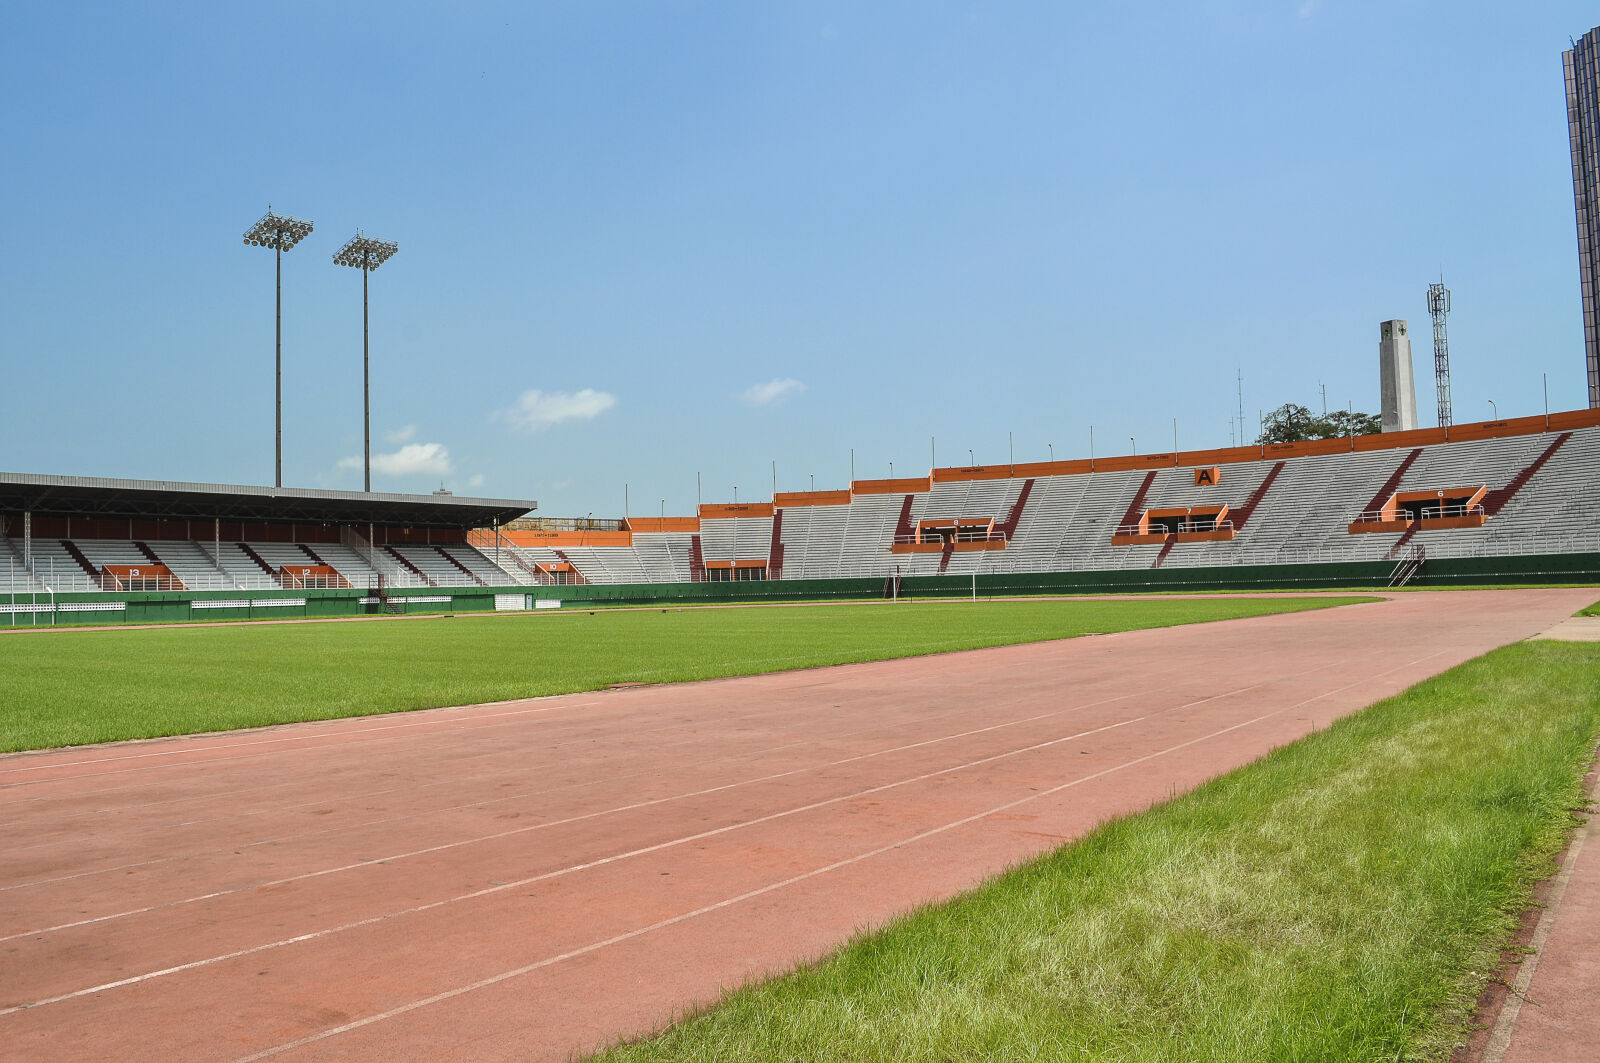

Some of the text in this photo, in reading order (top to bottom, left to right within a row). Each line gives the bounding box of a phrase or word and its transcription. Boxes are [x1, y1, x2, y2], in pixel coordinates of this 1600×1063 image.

[1198, 470, 1212, 483] A
[129, 568, 140, 577] 13
[302, 568, 311, 576] 12
